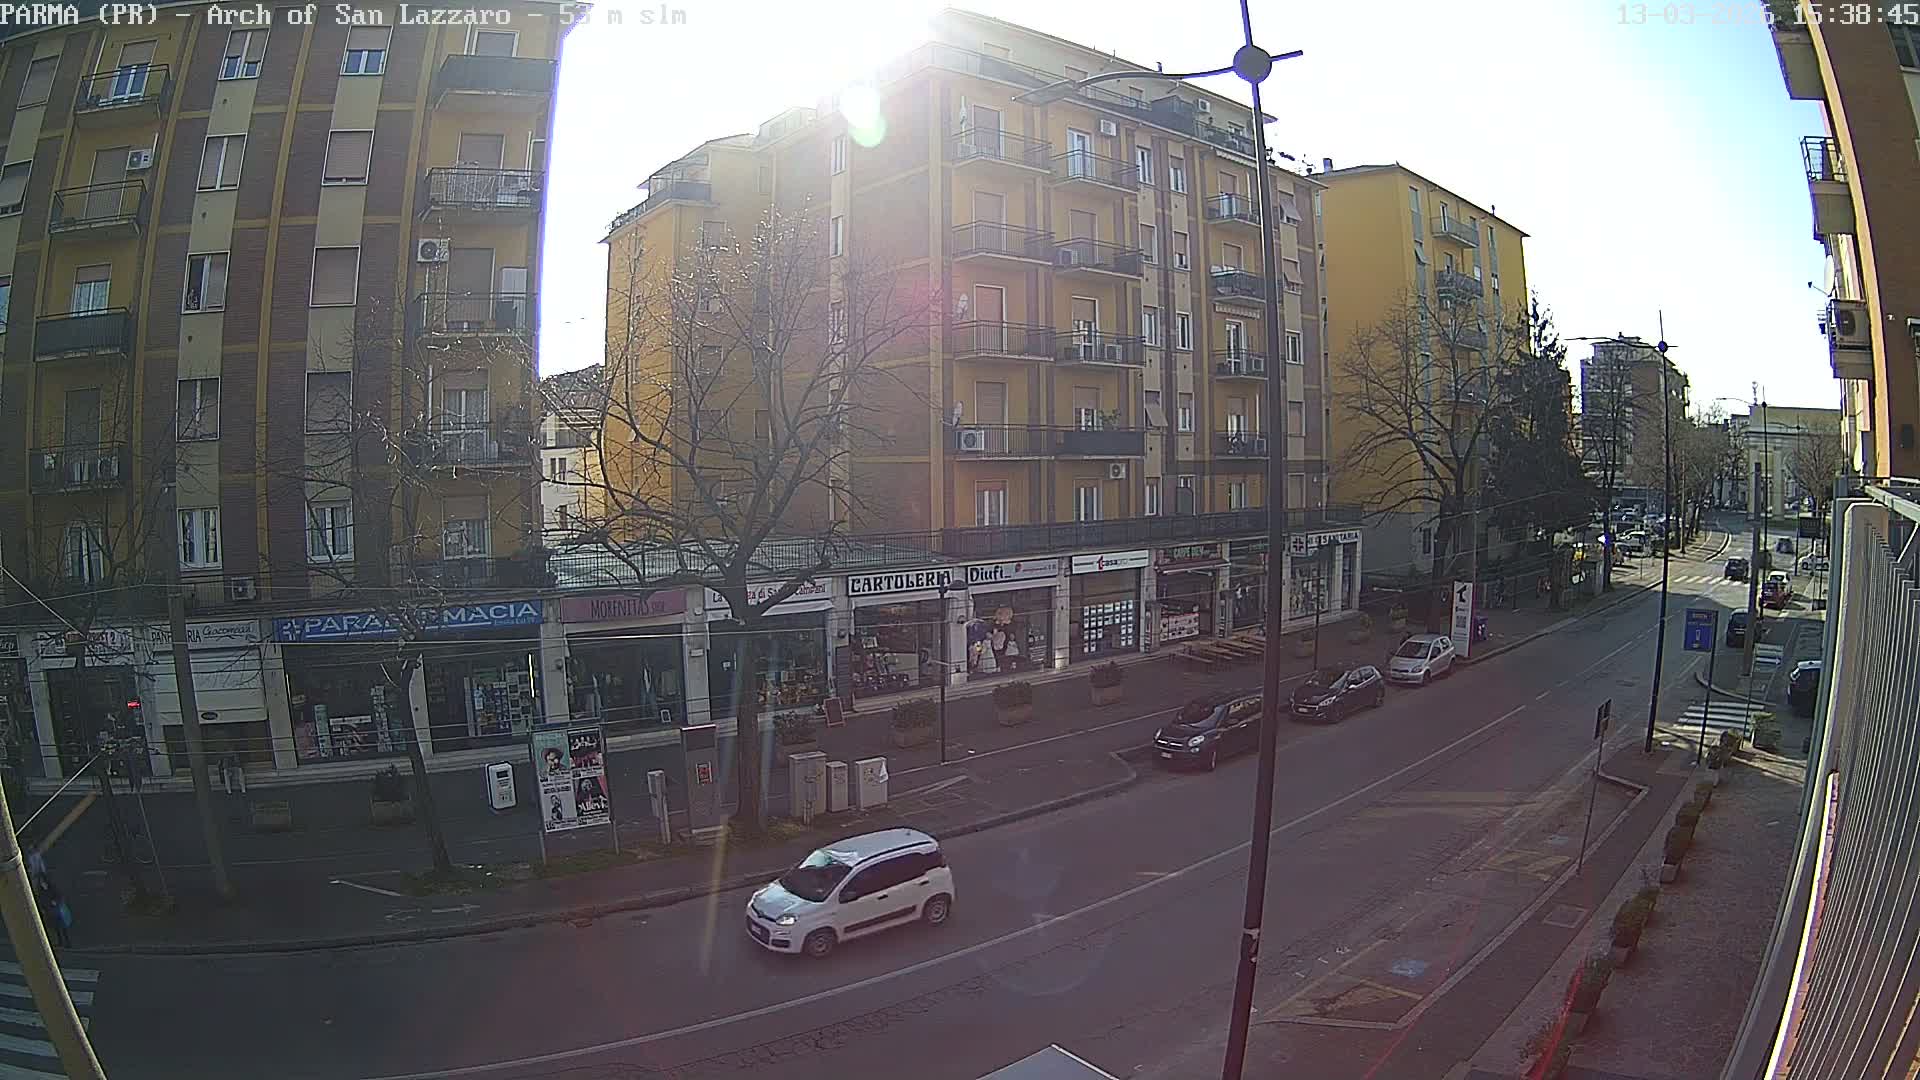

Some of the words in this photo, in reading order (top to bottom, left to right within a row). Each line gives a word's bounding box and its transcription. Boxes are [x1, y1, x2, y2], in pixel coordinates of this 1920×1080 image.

[850, 570, 952, 593] CARTOLERIA
[304, 602, 538, 634] PARAFMACIA
[151, 629, 202, 646] PANRIA
